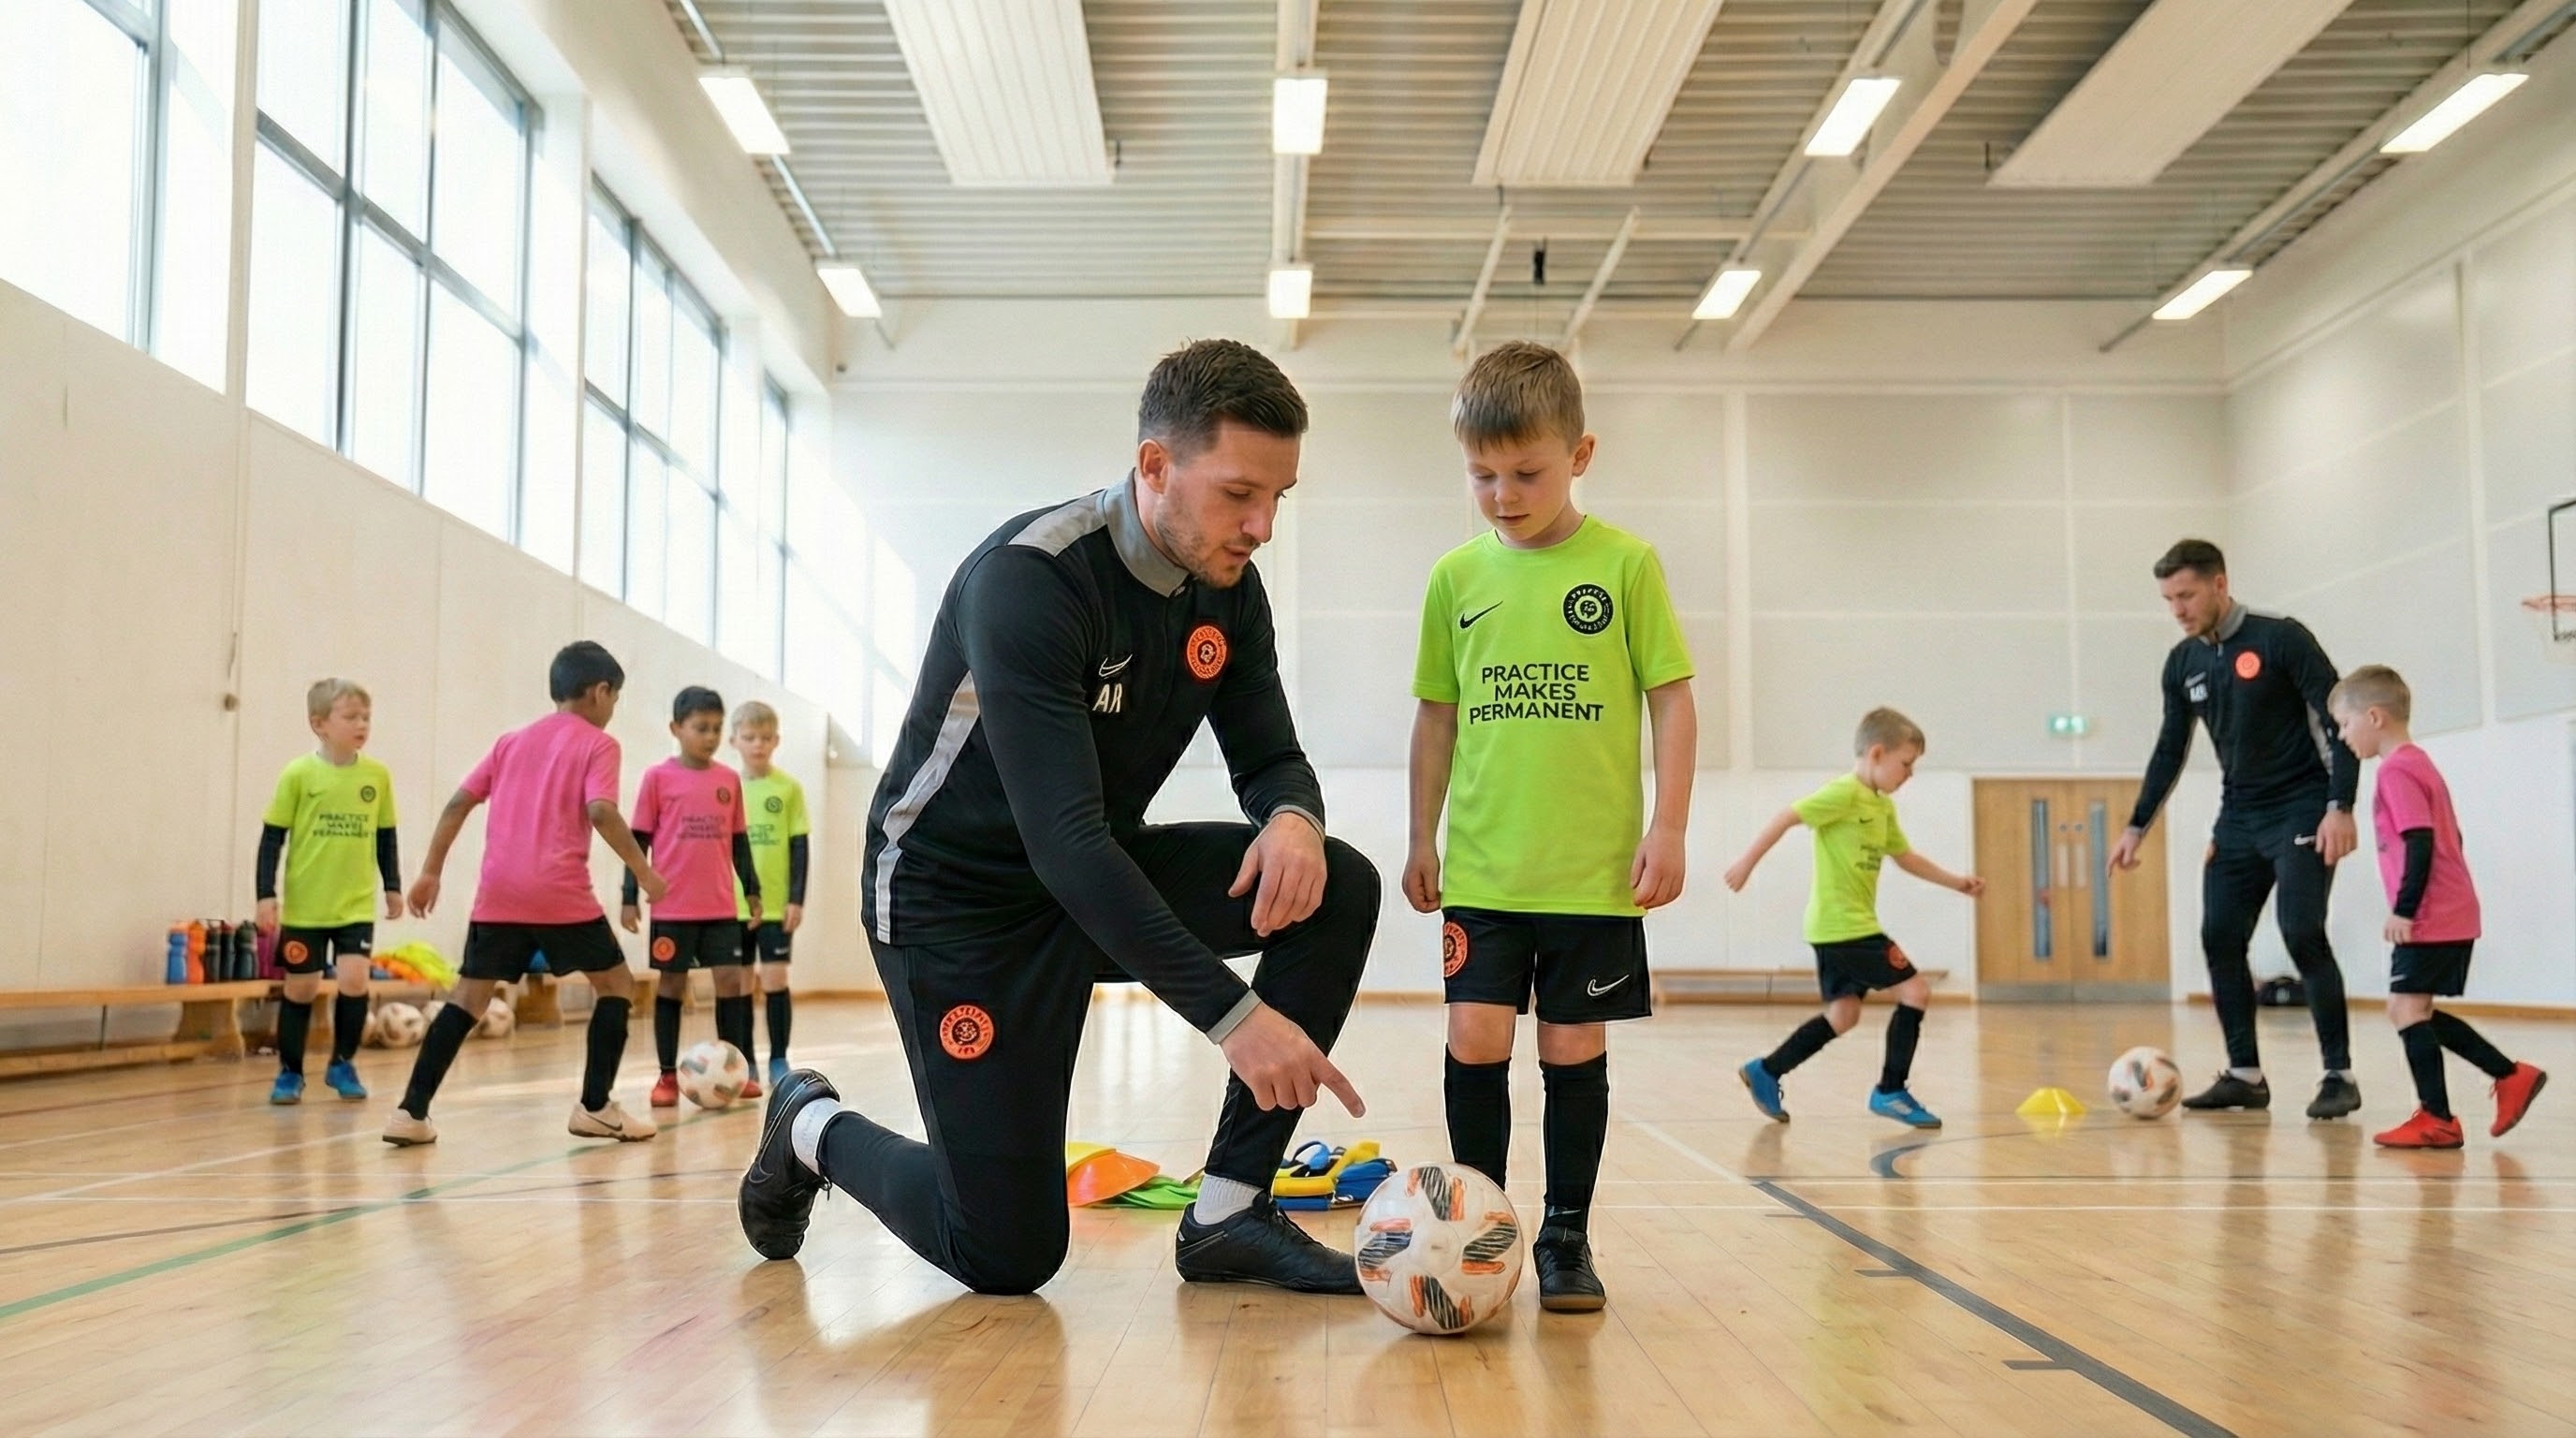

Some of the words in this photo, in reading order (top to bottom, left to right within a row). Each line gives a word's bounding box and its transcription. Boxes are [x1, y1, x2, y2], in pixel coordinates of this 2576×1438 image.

[1482, 663, 1589, 683] PRACTICE
[1092, 682, 1123, 713] AR
[1495, 682, 1576, 701] MAKES
[1470, 702, 1603, 725] PERMANENT
